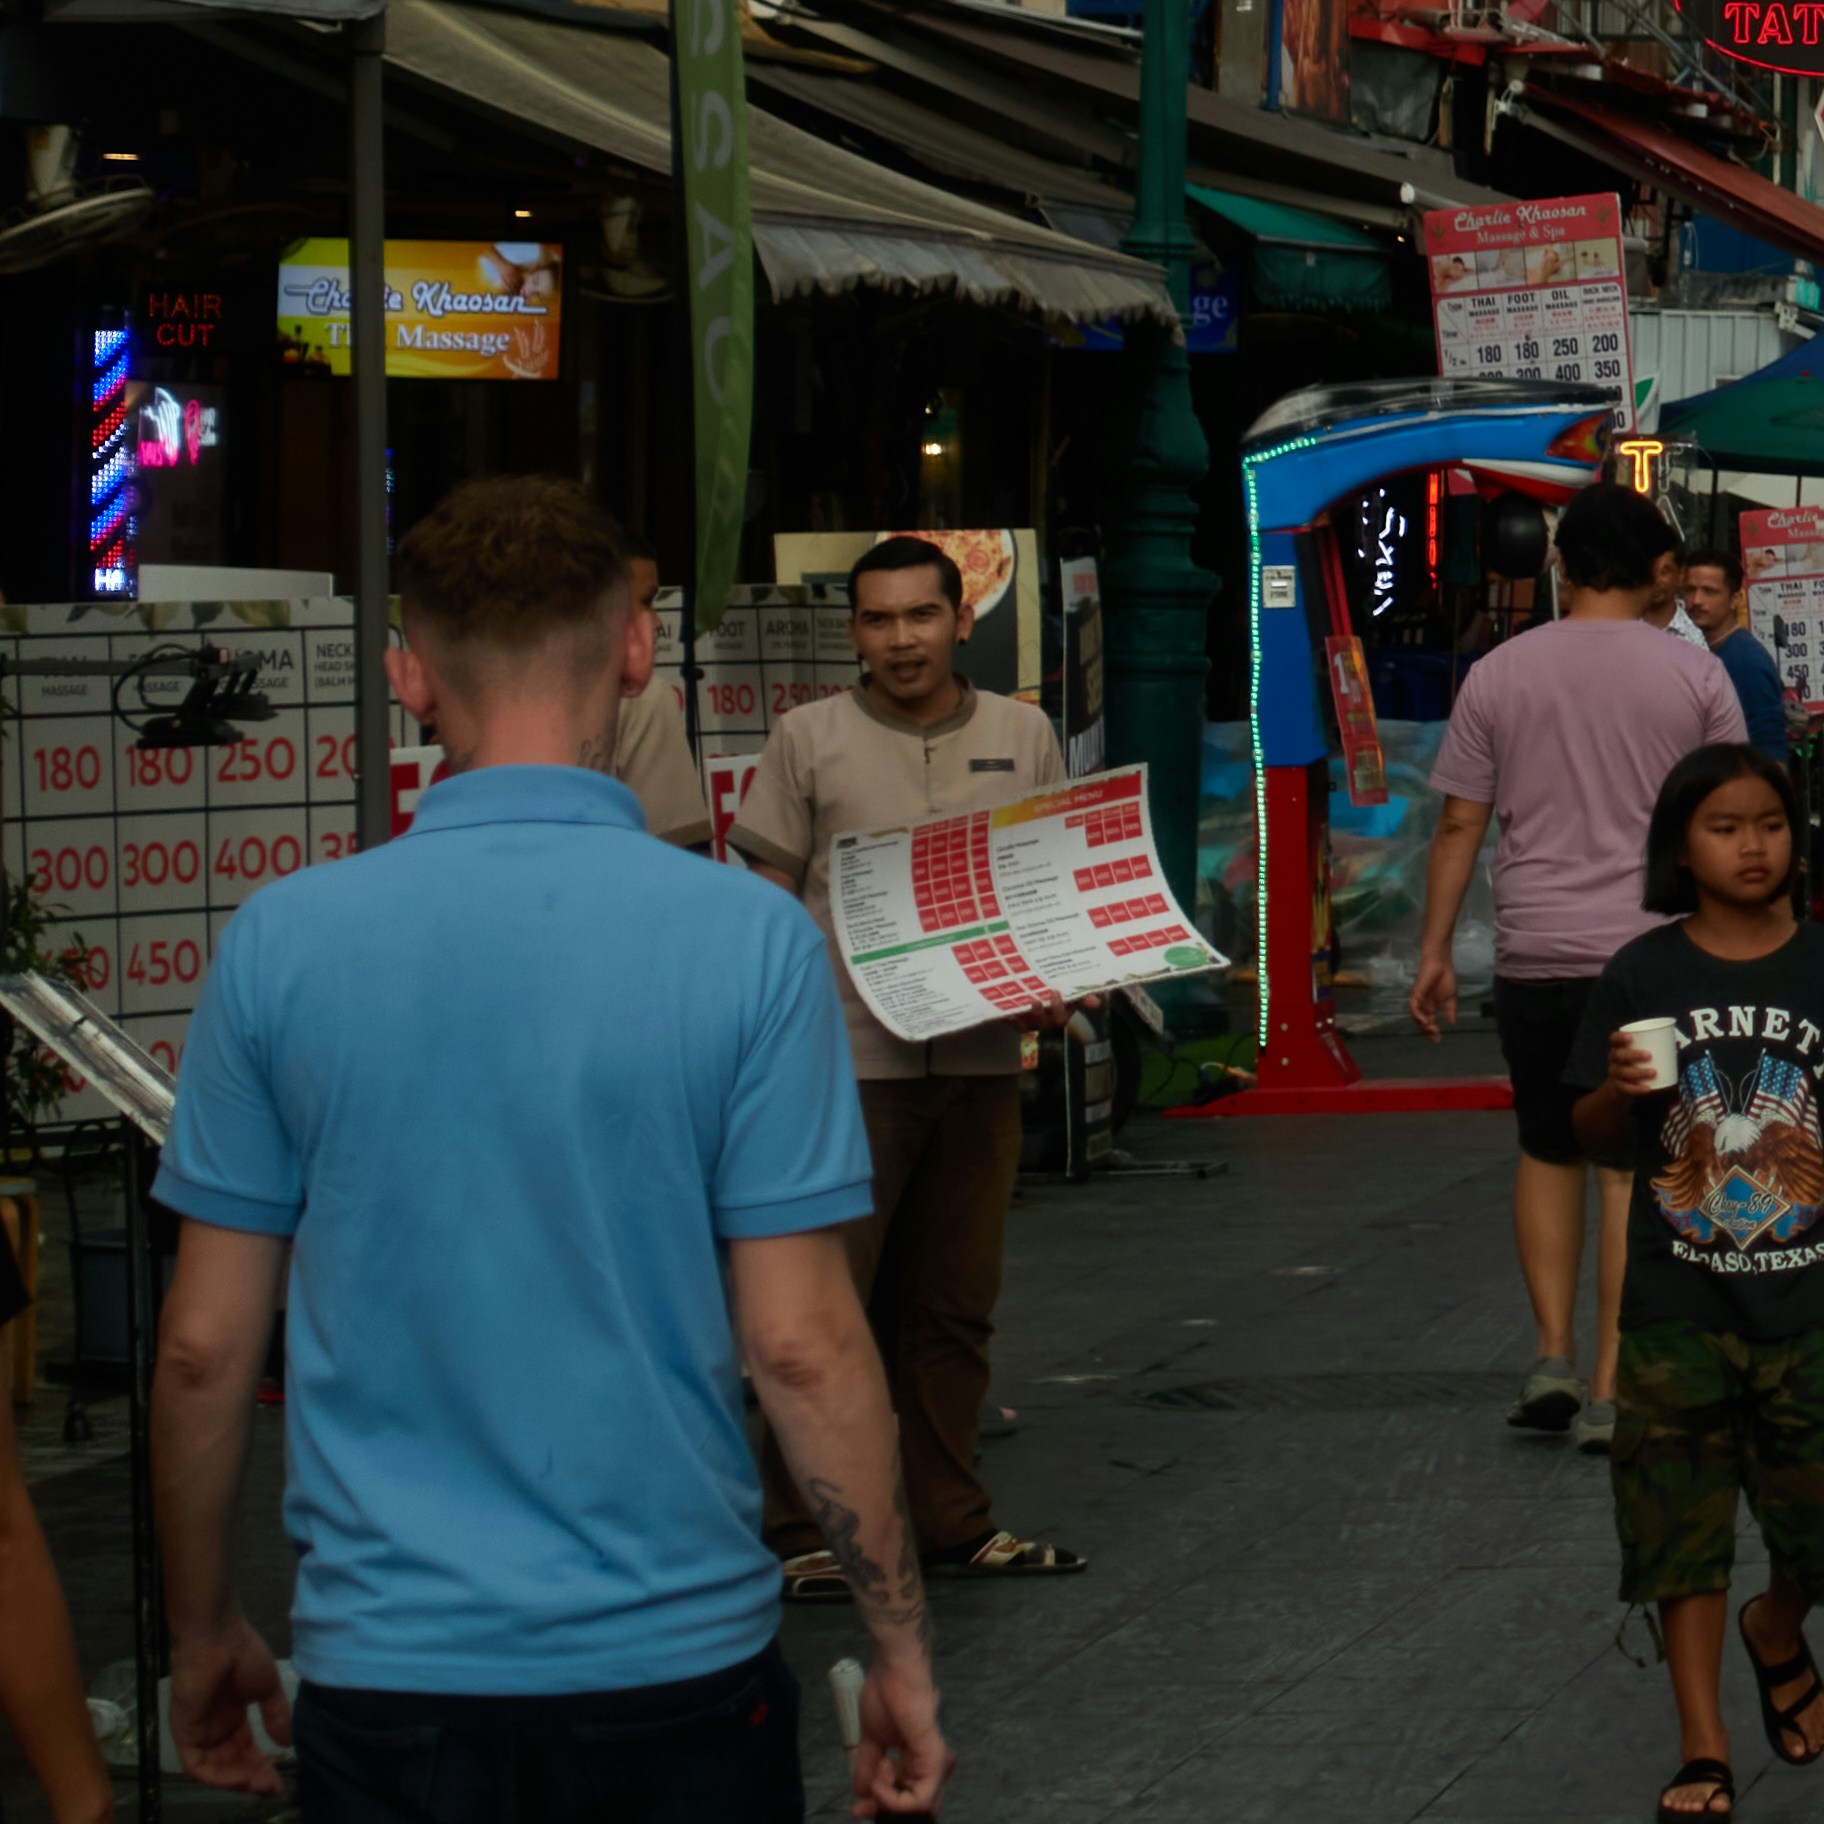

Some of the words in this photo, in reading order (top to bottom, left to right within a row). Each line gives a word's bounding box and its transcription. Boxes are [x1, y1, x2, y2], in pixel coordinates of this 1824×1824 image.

[1454, 209, 1512, 232] Charlie
[1516, 204, 1587, 227] Khaosan
[1476, 228, 1527, 245] Massage
[1529, 226, 1540, 239] &
[1542, 225, 1566, 241] Spa
[148, 292, 224, 319] HAIR
[411, 280, 549, 318] Khaosan
[1471, 297, 1496, 308] THAI
[1507, 293, 1535, 304] FOOT
[1551, 290, 1570, 301] OIL
[156, 323, 217, 348] CUT
[395, 323, 512, 358] Massage
[1477, 345, 1502, 363] 180
[1515, 341, 1540, 360] 180
[1553, 337, 1579, 357] 250
[1592, 334, 1619, 353] 200
[1555, 364, 1581, 381] 400
[1594, 360, 1620, 378] 350
[1780, 582, 1803, 591] THAI
[1785, 622, 1806, 637] 180
[1785, 643, 1808, 659] 300
[1787, 663, 1809, 679] 450
[41, 684, 88, 697] MASSAGE
[34, 746, 101, 791] 180
[127, 743, 193, 788] 180
[217, 736, 295, 783] 250
[708, 684, 755, 715] 180
[1073, 788, 1104, 806] MENU
[31, 846, 109, 893] 300
[123, 841, 199, 887] 300
[214, 835, 301, 880] 400
[127, 940, 200, 986] 450
